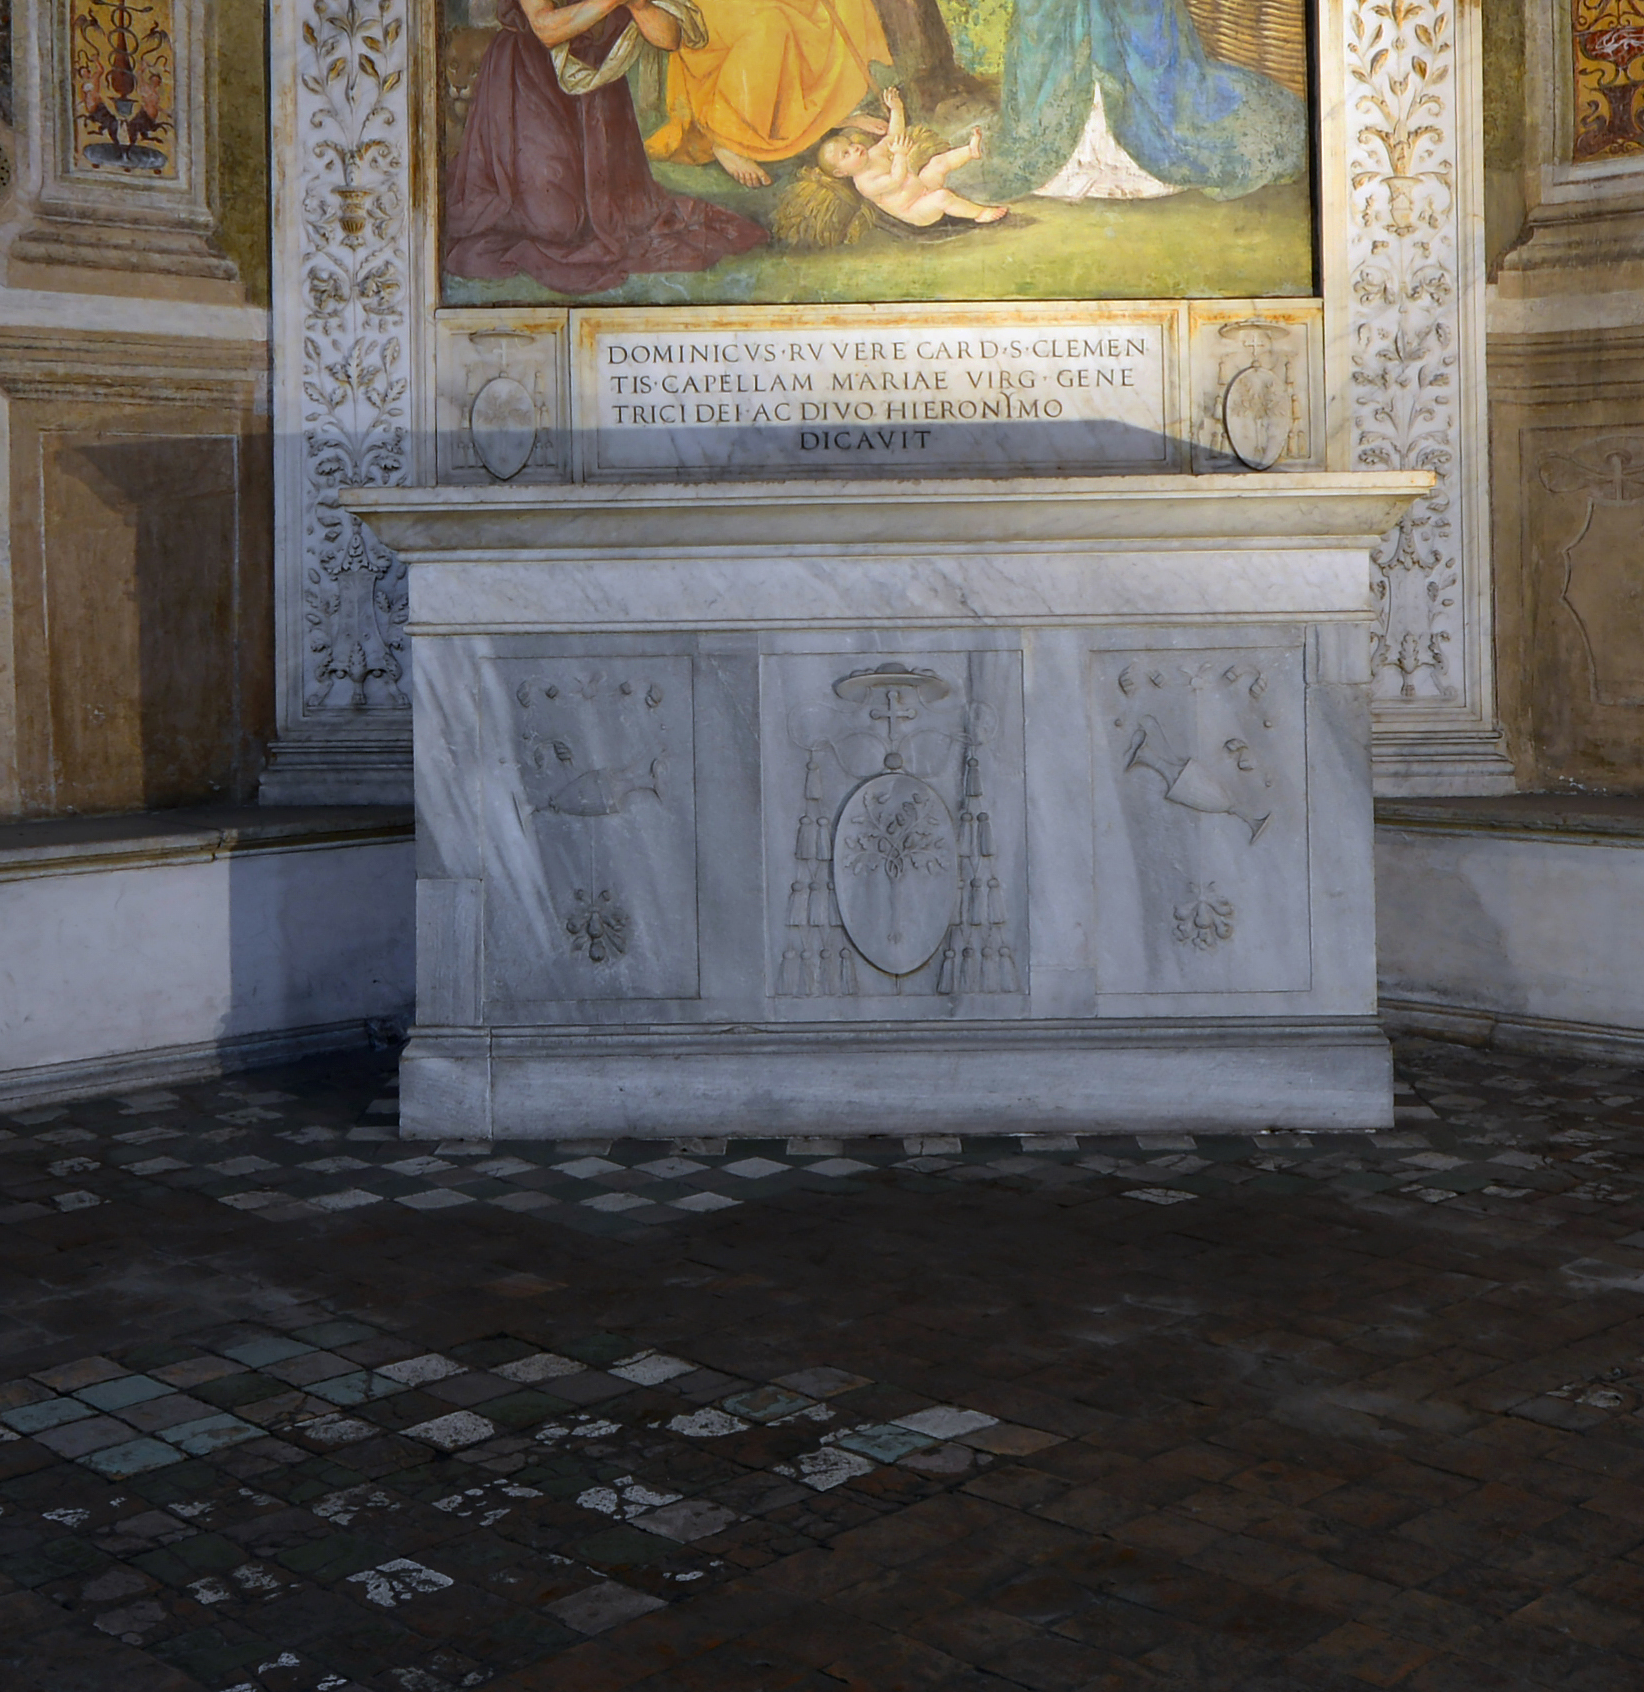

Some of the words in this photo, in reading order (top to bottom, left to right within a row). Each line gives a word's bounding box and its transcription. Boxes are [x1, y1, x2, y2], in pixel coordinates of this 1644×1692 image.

[832, 371, 949, 391] MARIAE
[1057, 368, 1135, 388] GENE
[611, 405, 687, 424] TRICI
[801, 402, 874, 421] DIVO
[886, 391, 1063, 421] HIERONYMO
[800, 430, 931, 451] DICAVIT
